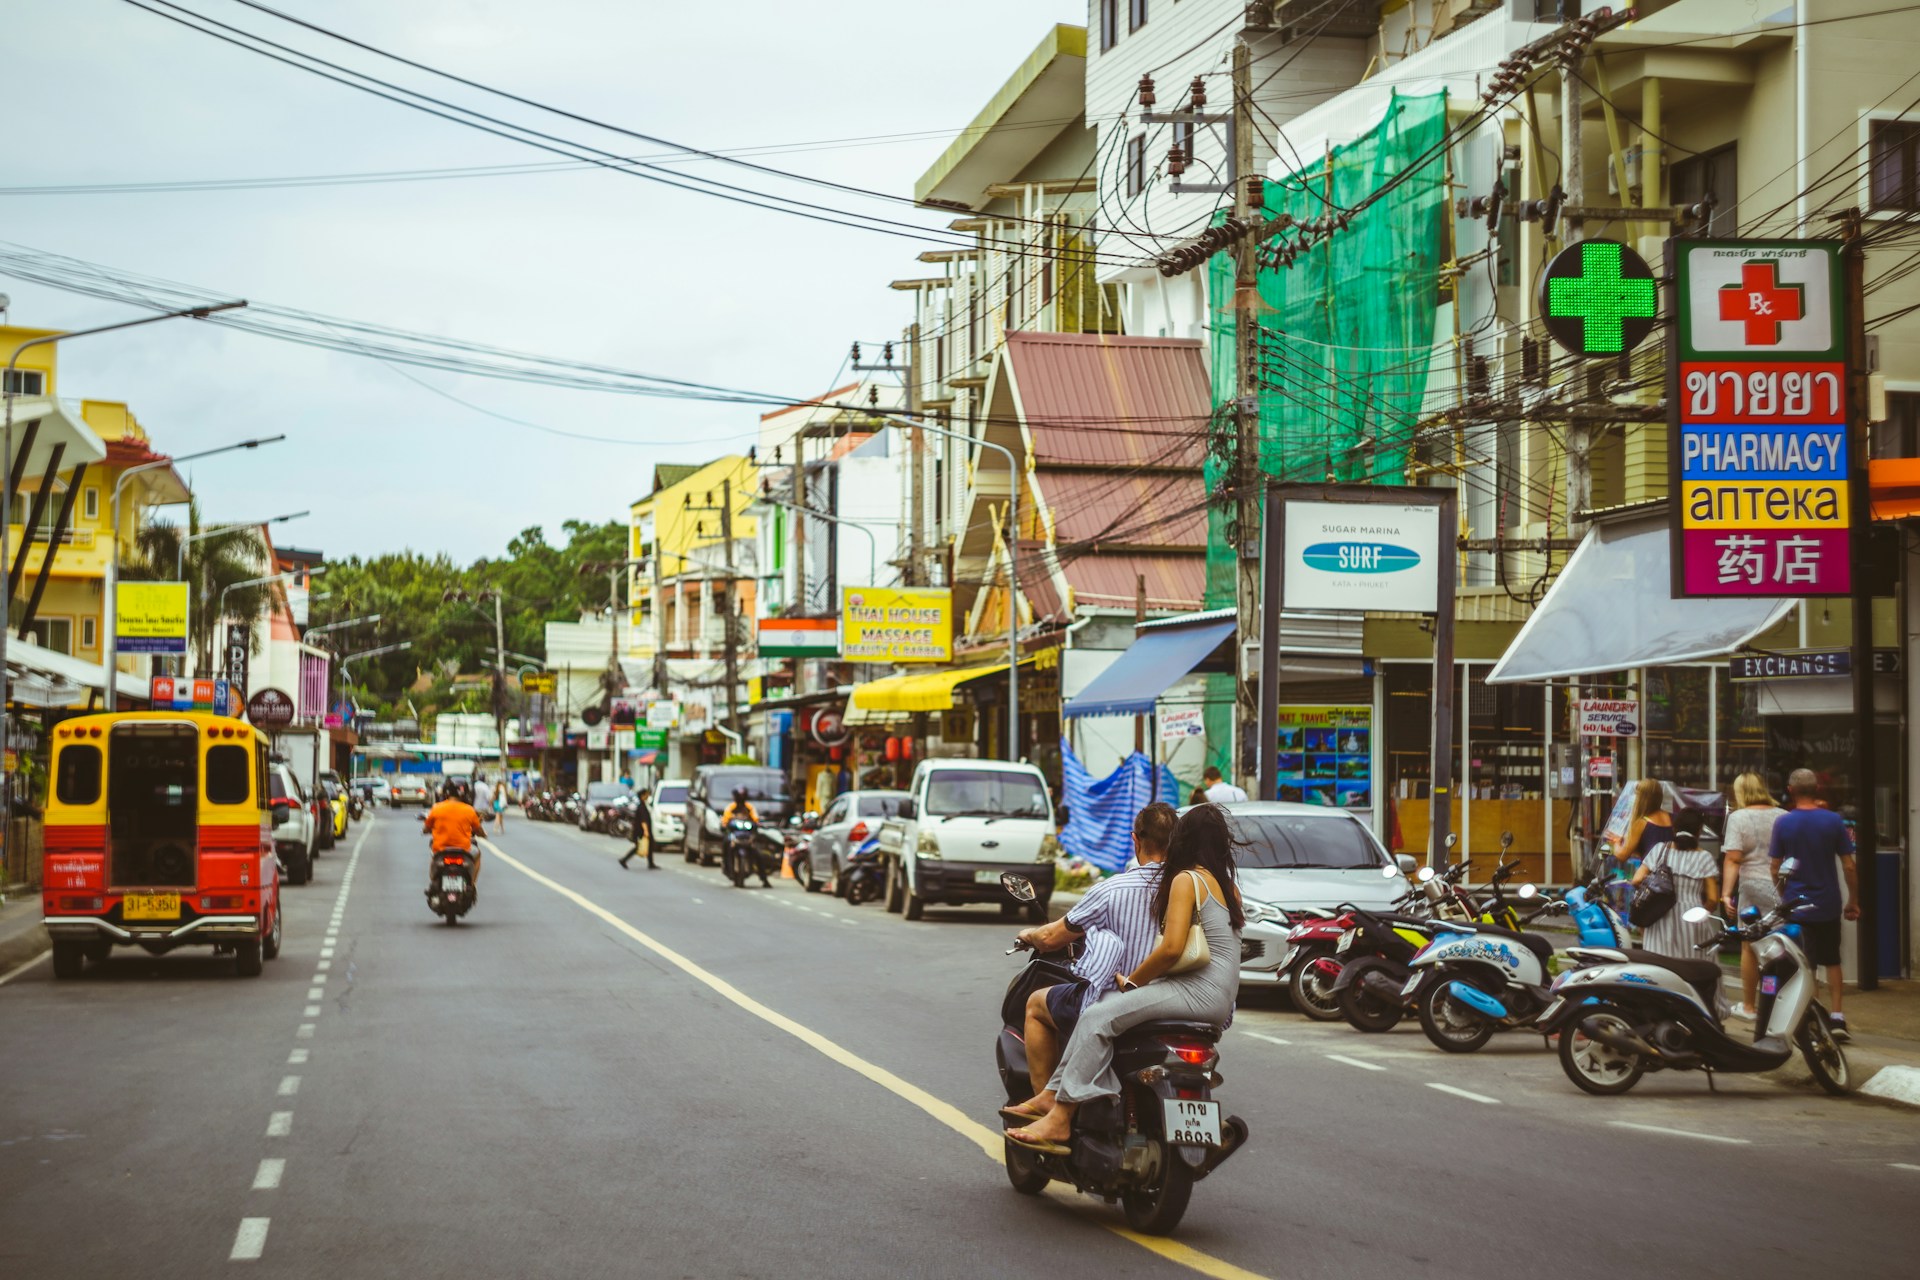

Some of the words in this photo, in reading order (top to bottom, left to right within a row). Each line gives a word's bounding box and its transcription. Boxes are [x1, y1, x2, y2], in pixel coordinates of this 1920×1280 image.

[1686, 371, 1839, 416] ขายยา
[1683, 432, 1842, 472] PHARMACY
[1690, 486, 1839, 521] аптека
[1322, 525, 1356, 534] SUGAR
[1360, 526, 1400, 535] MARINA
[1339, 546, 1382, 569] SURF
[1715, 535, 1821, 585] 药店
[1359, 581, 1389, 589] PHUKET
[849, 606, 884, 622] THAI
[887, 607, 941, 624] HOUSE
[861, 628, 932, 644] MASSAGE
[1745, 654, 1835, 676] EXCHANGE
[1583, 701, 1637, 713] LAUNDRY
[1588, 713, 1627, 722] SERVICE
[1174, 1129, 1213, 1144] 8603
